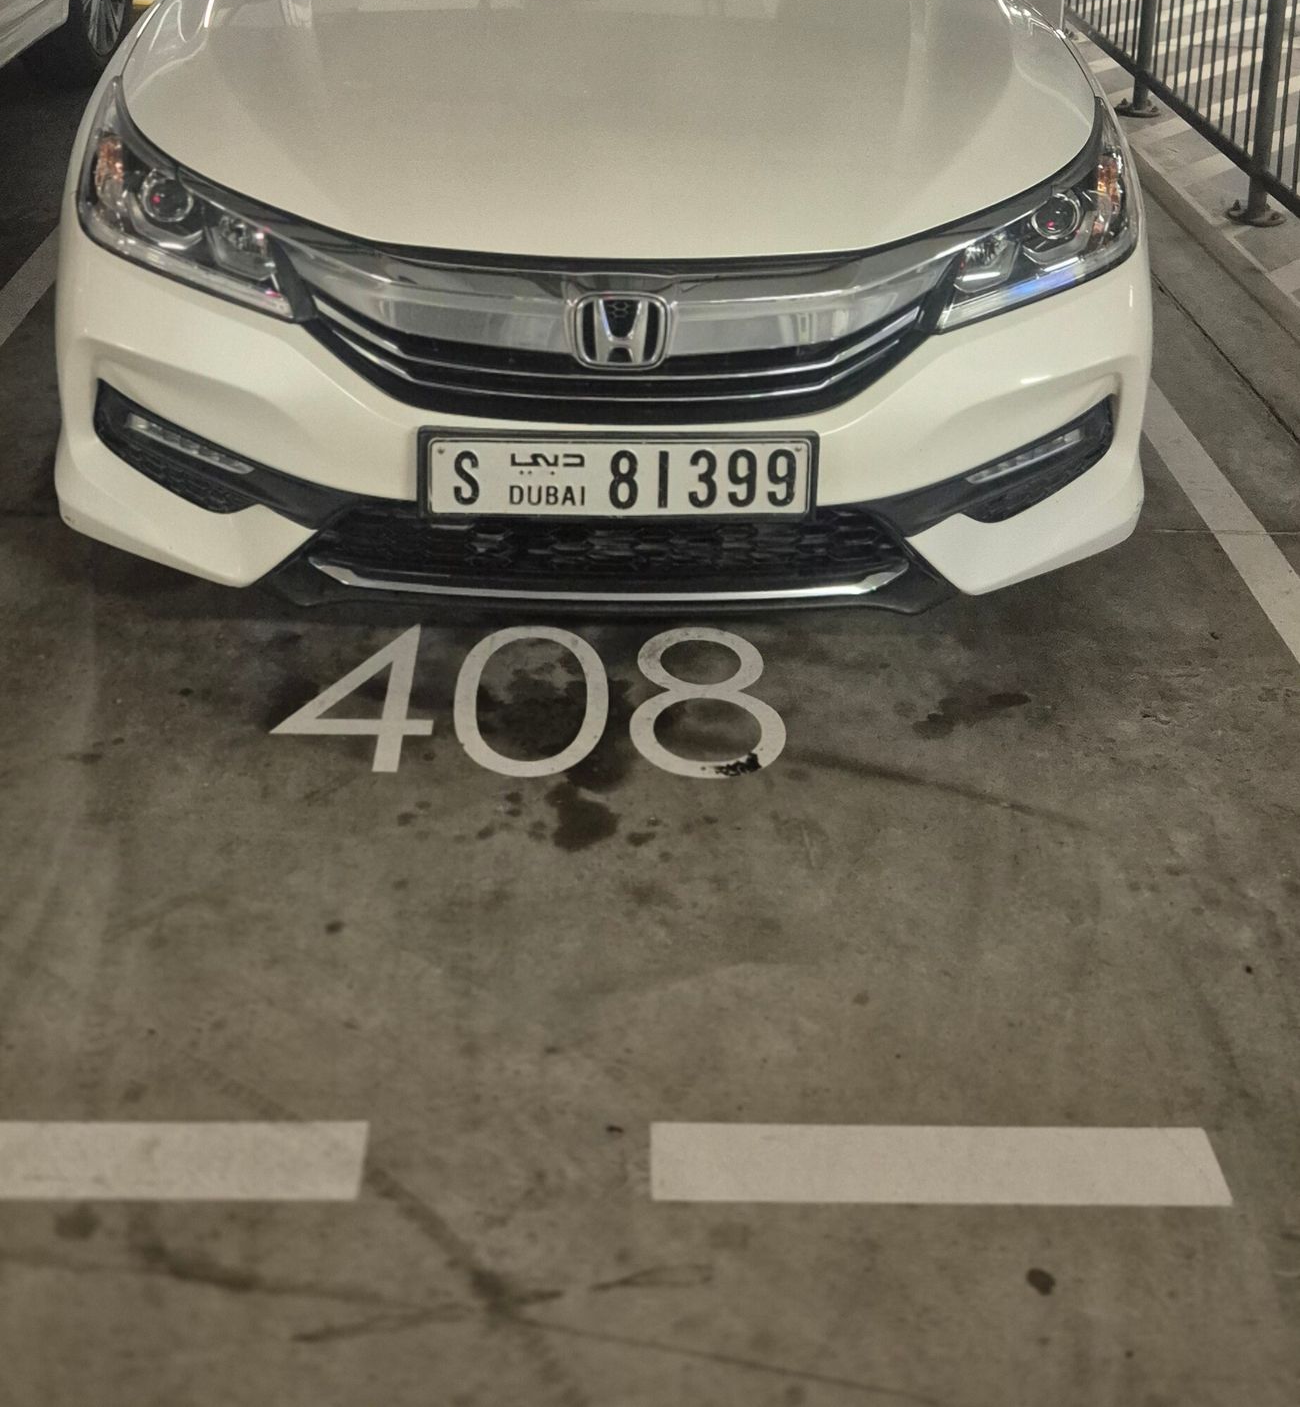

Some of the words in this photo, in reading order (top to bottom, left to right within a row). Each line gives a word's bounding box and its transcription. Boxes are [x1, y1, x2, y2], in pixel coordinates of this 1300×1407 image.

[453, 450, 480, 506] S
[510, 453, 585, 476] دبي
[609, 448, 797, 510] 81399
[509, 485, 586, 506] DUBAI
[269, 624, 787, 778] 408
